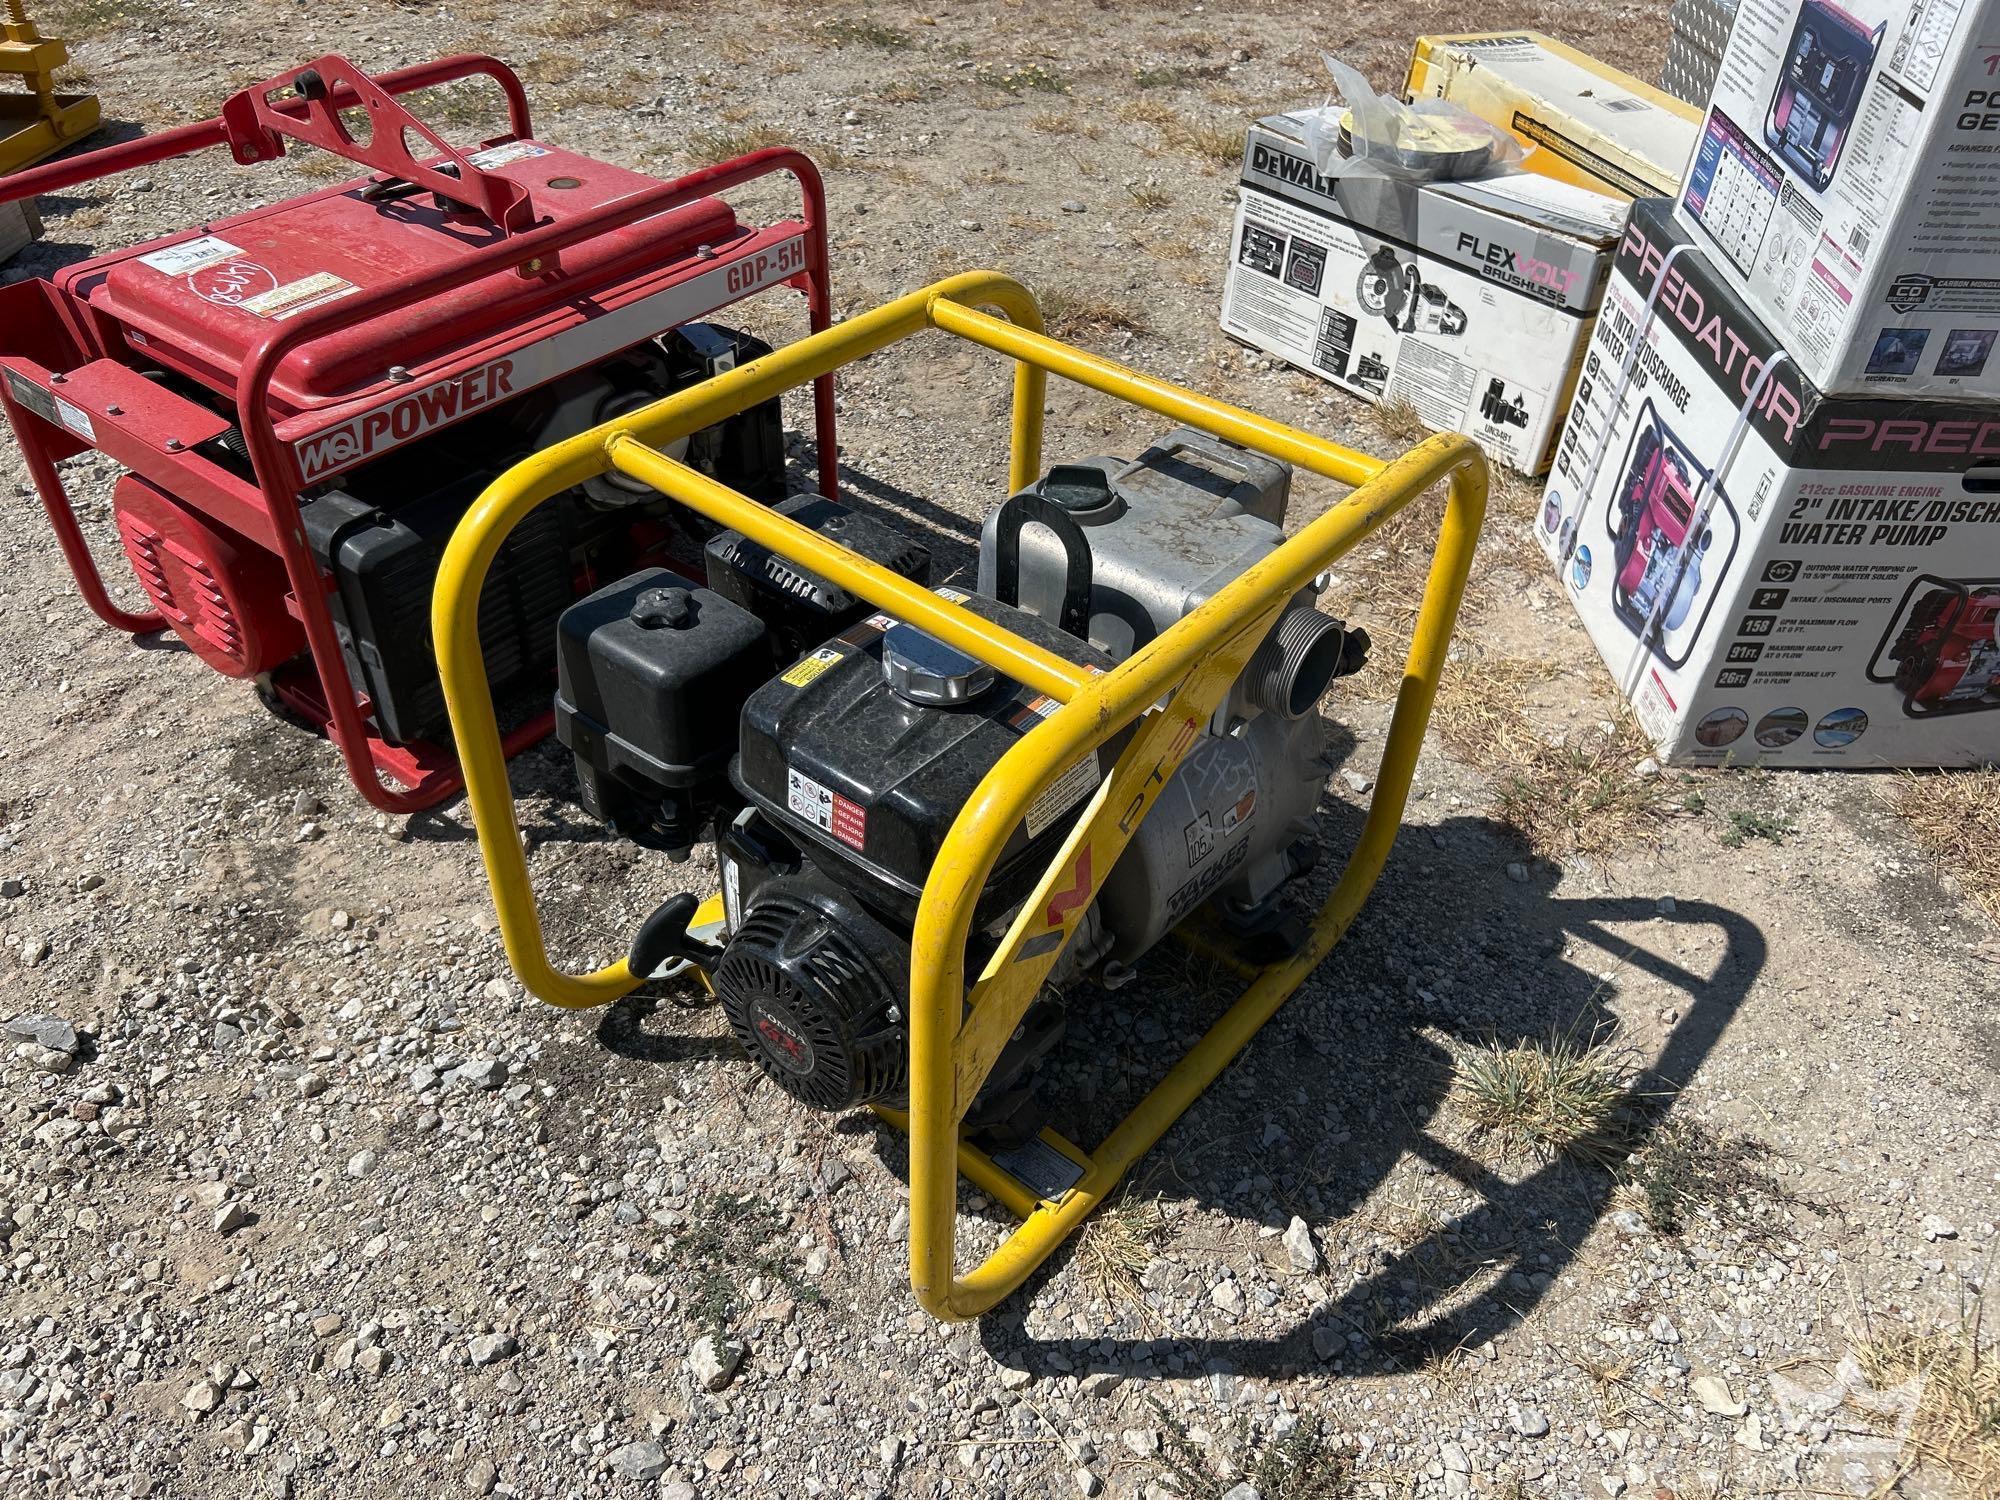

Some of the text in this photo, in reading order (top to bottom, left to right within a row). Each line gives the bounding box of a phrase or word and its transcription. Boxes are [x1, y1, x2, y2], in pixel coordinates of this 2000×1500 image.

[727, 245, 803, 294] GDP-5H
[1457, 232, 1583, 292] FLEXVOLT
[1483, 264, 1567, 304] BRUSHLESS
[1896, 286, 1922, 296] CO
[1597, 317, 1624, 364] WATER
[1620, 222, 1802, 444] PREDATOR
[1613, 308, 1691, 415] INTAE/DISCHARGE
[300, 360, 514, 476] MQ POWER
[1484, 424, 1512, 443] UN3481
[1799, 484, 1944, 497] 212cc GASOLINE ENGINE
[1788, 498, 1822, 520] 2"
[1780, 523, 1948, 546] WATER PUMP
[1760, 593, 1778, 606] 2"
[1745, 620, 1769, 632] 158
[838, 810, 863, 828] GEFAHR
[839, 800, 864, 817] DANGER
[837, 830, 863, 848] DANGER
[838, 820, 863, 838] PELIGRO
[1190, 834, 1207, 863] 105
[1168, 835, 1249, 910] WACKER
[757, 1005, 807, 1046] HONDA
